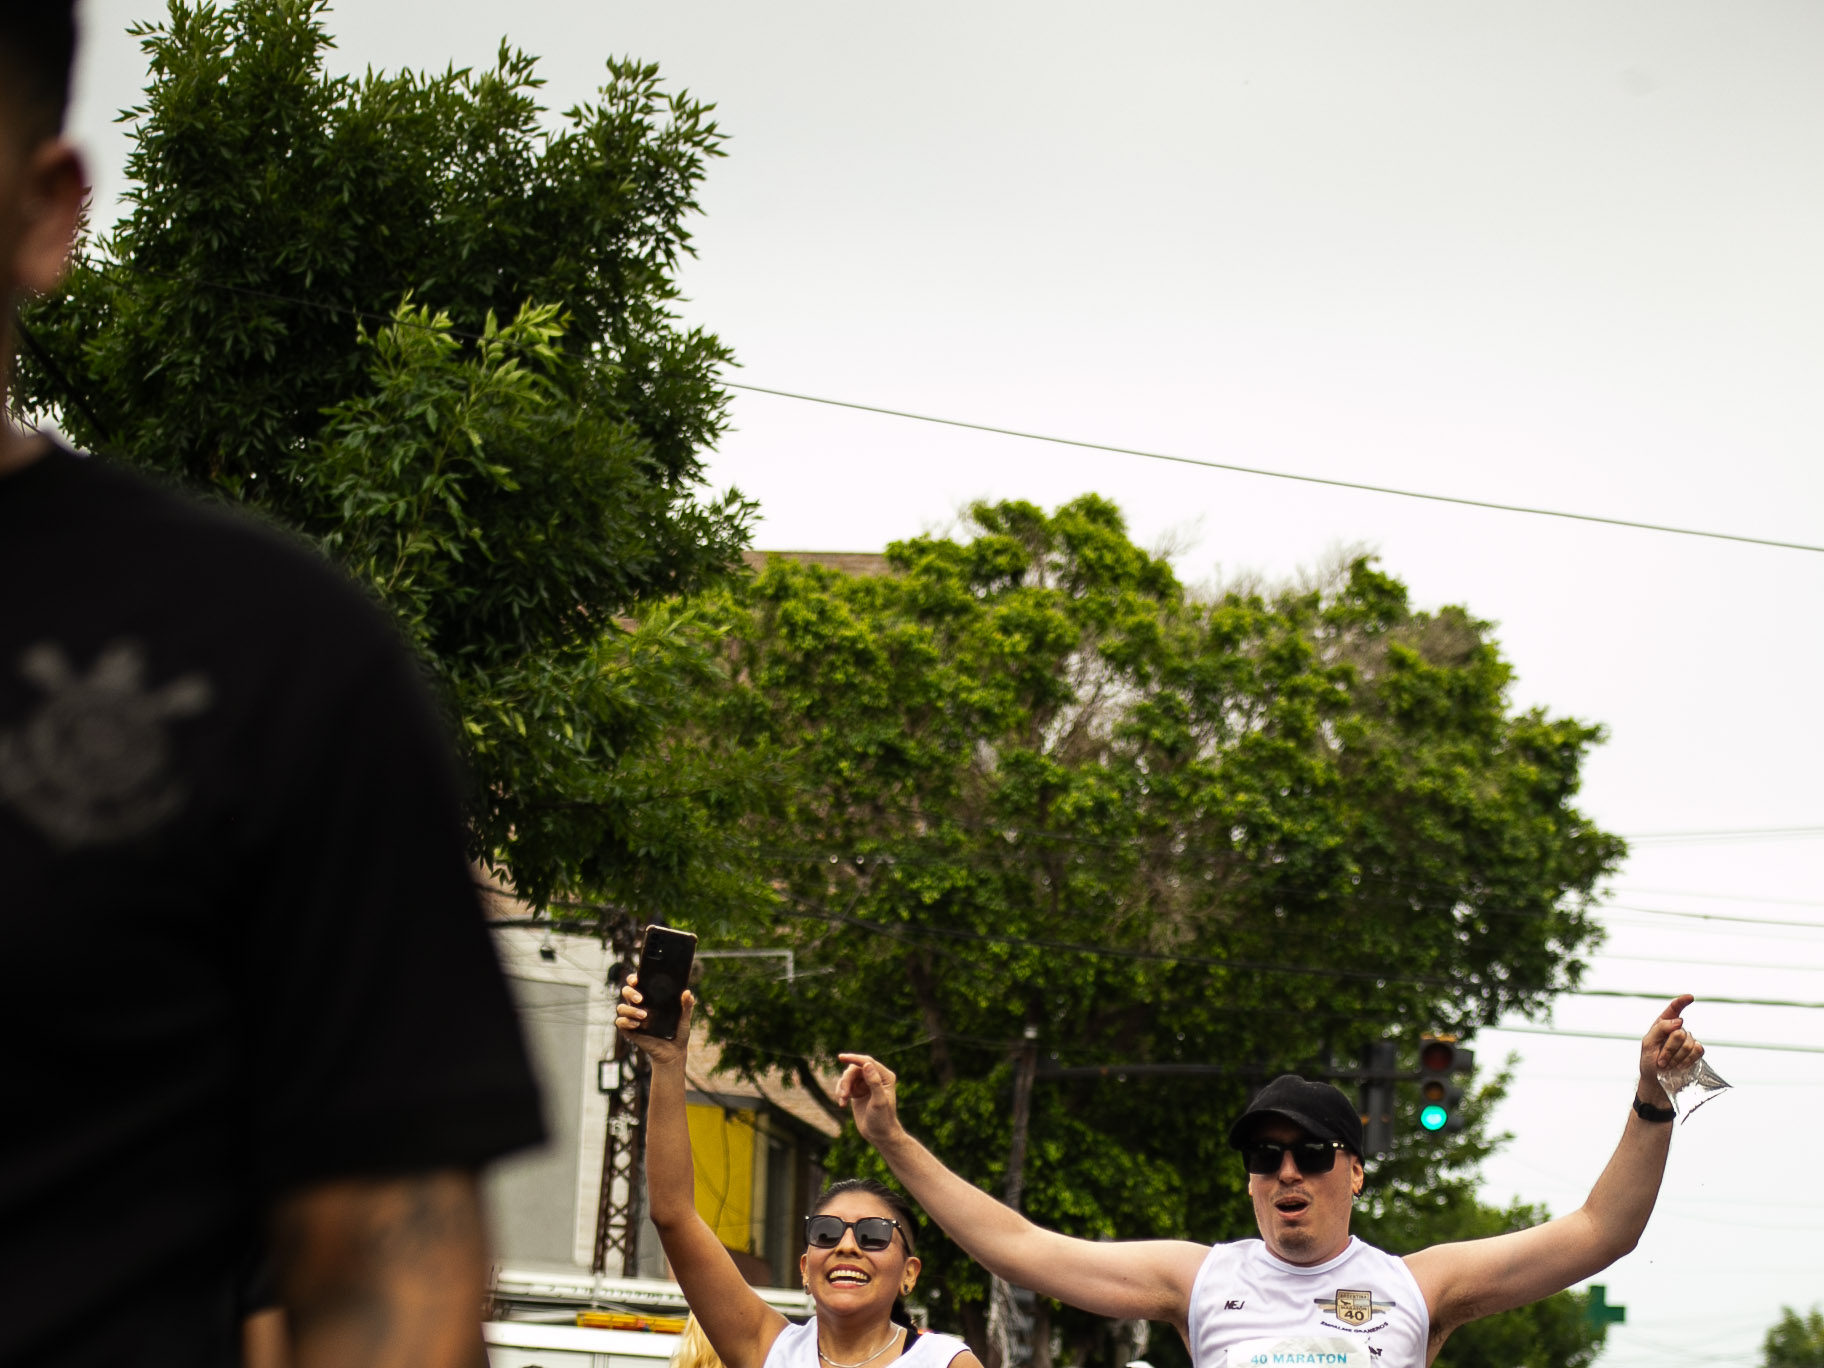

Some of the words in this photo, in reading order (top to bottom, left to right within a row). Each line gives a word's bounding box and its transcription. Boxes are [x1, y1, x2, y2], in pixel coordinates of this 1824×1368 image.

[1224, 1300, 1245, 1310] NEJ
[1344, 1310, 1364, 1321] 40
[1320, 1321, 1352, 1332] EMPALME
[1353, 1321, 1389, 1333] GRANEROS
[1250, 1354, 1268, 1365] 40
[1273, 1353, 1347, 1364] MARATON
